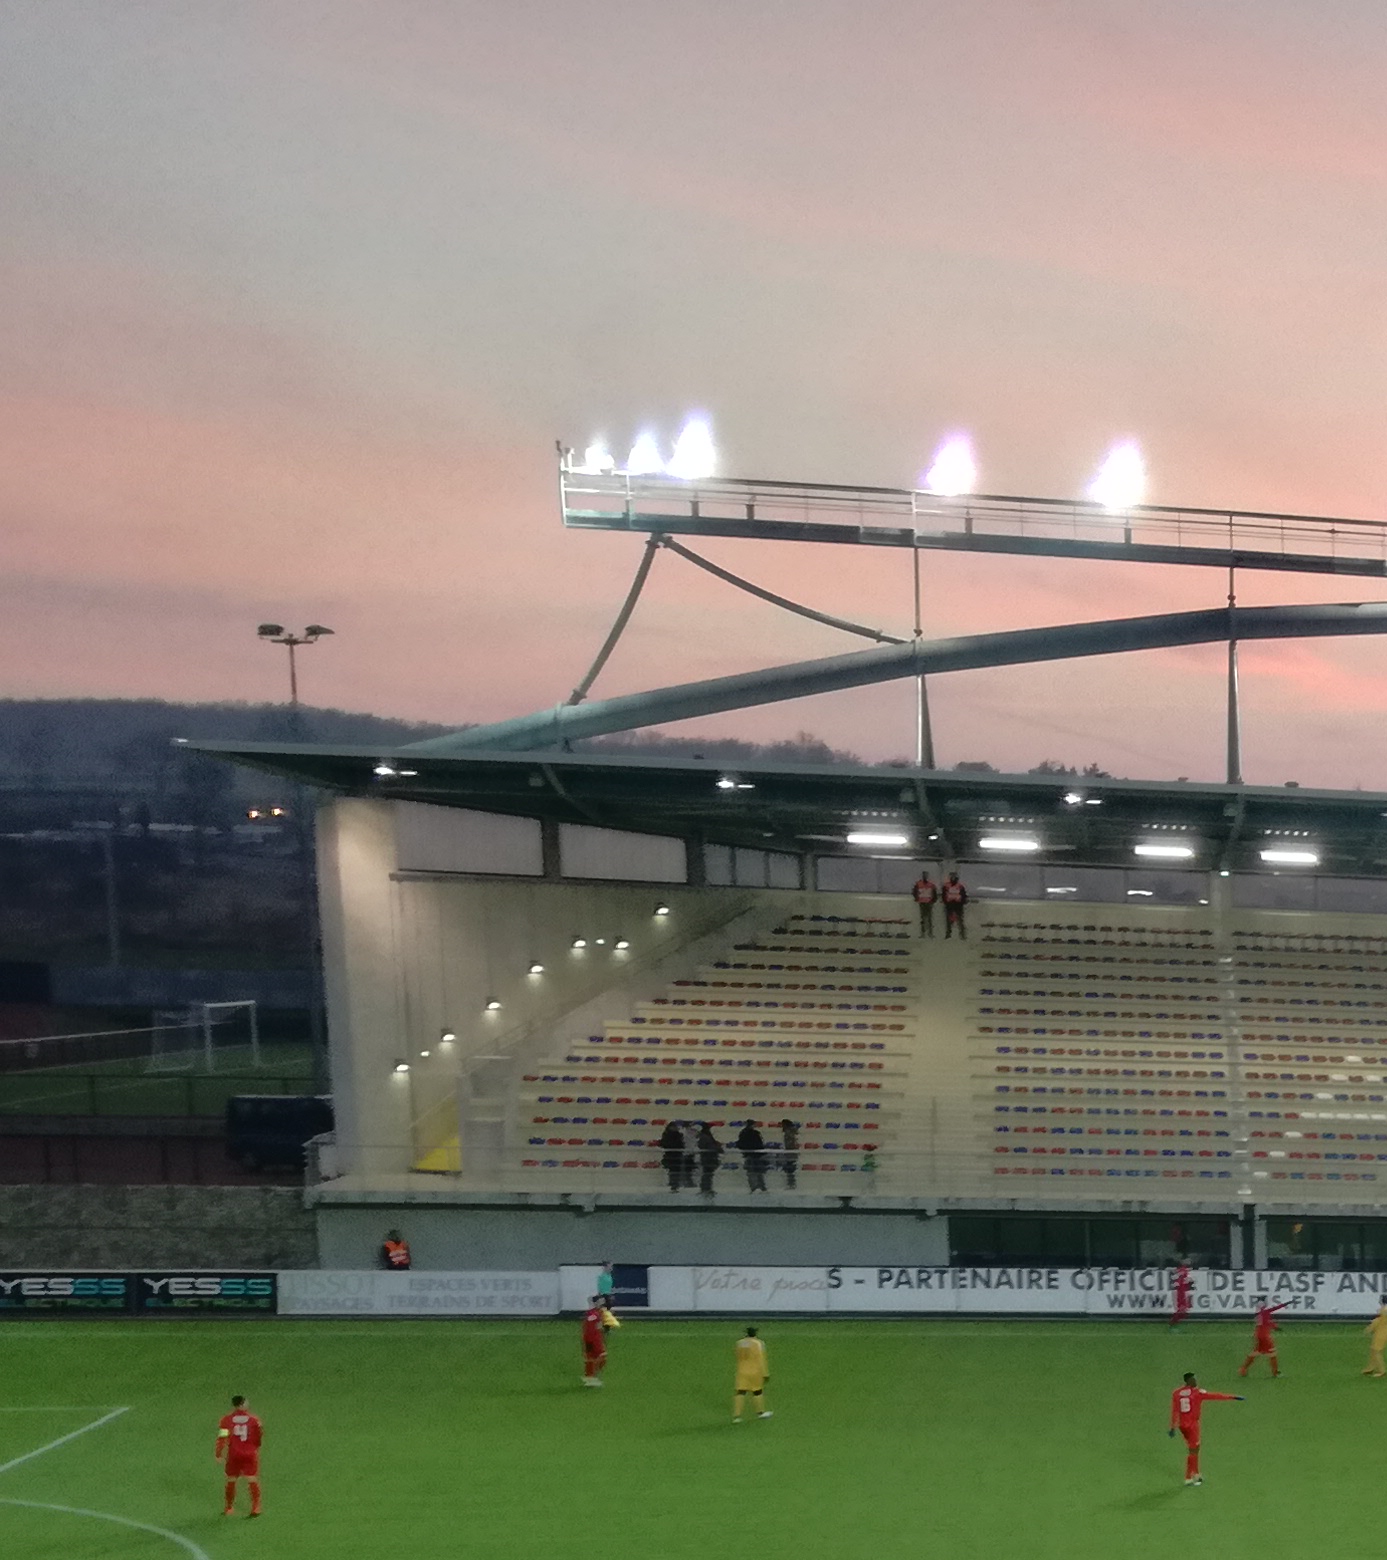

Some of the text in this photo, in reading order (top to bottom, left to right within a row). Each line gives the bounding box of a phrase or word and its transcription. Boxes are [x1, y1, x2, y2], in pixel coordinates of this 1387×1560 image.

[0, 1277, 126, 1295] YESSS
[143, 1277, 272, 1295] YESSS
[409, 1278, 533, 1292] ESPACES VERTS
[695, 1268, 763, 1291] Votre
[876, 1268, 1060, 1290] PARTENAIRE
[1211, 1272, 1245, 1292] DE
[1255, 1272, 1326, 1294] L'ASF
[386, 1295, 552, 1309] TERRAINS DE SPORT
